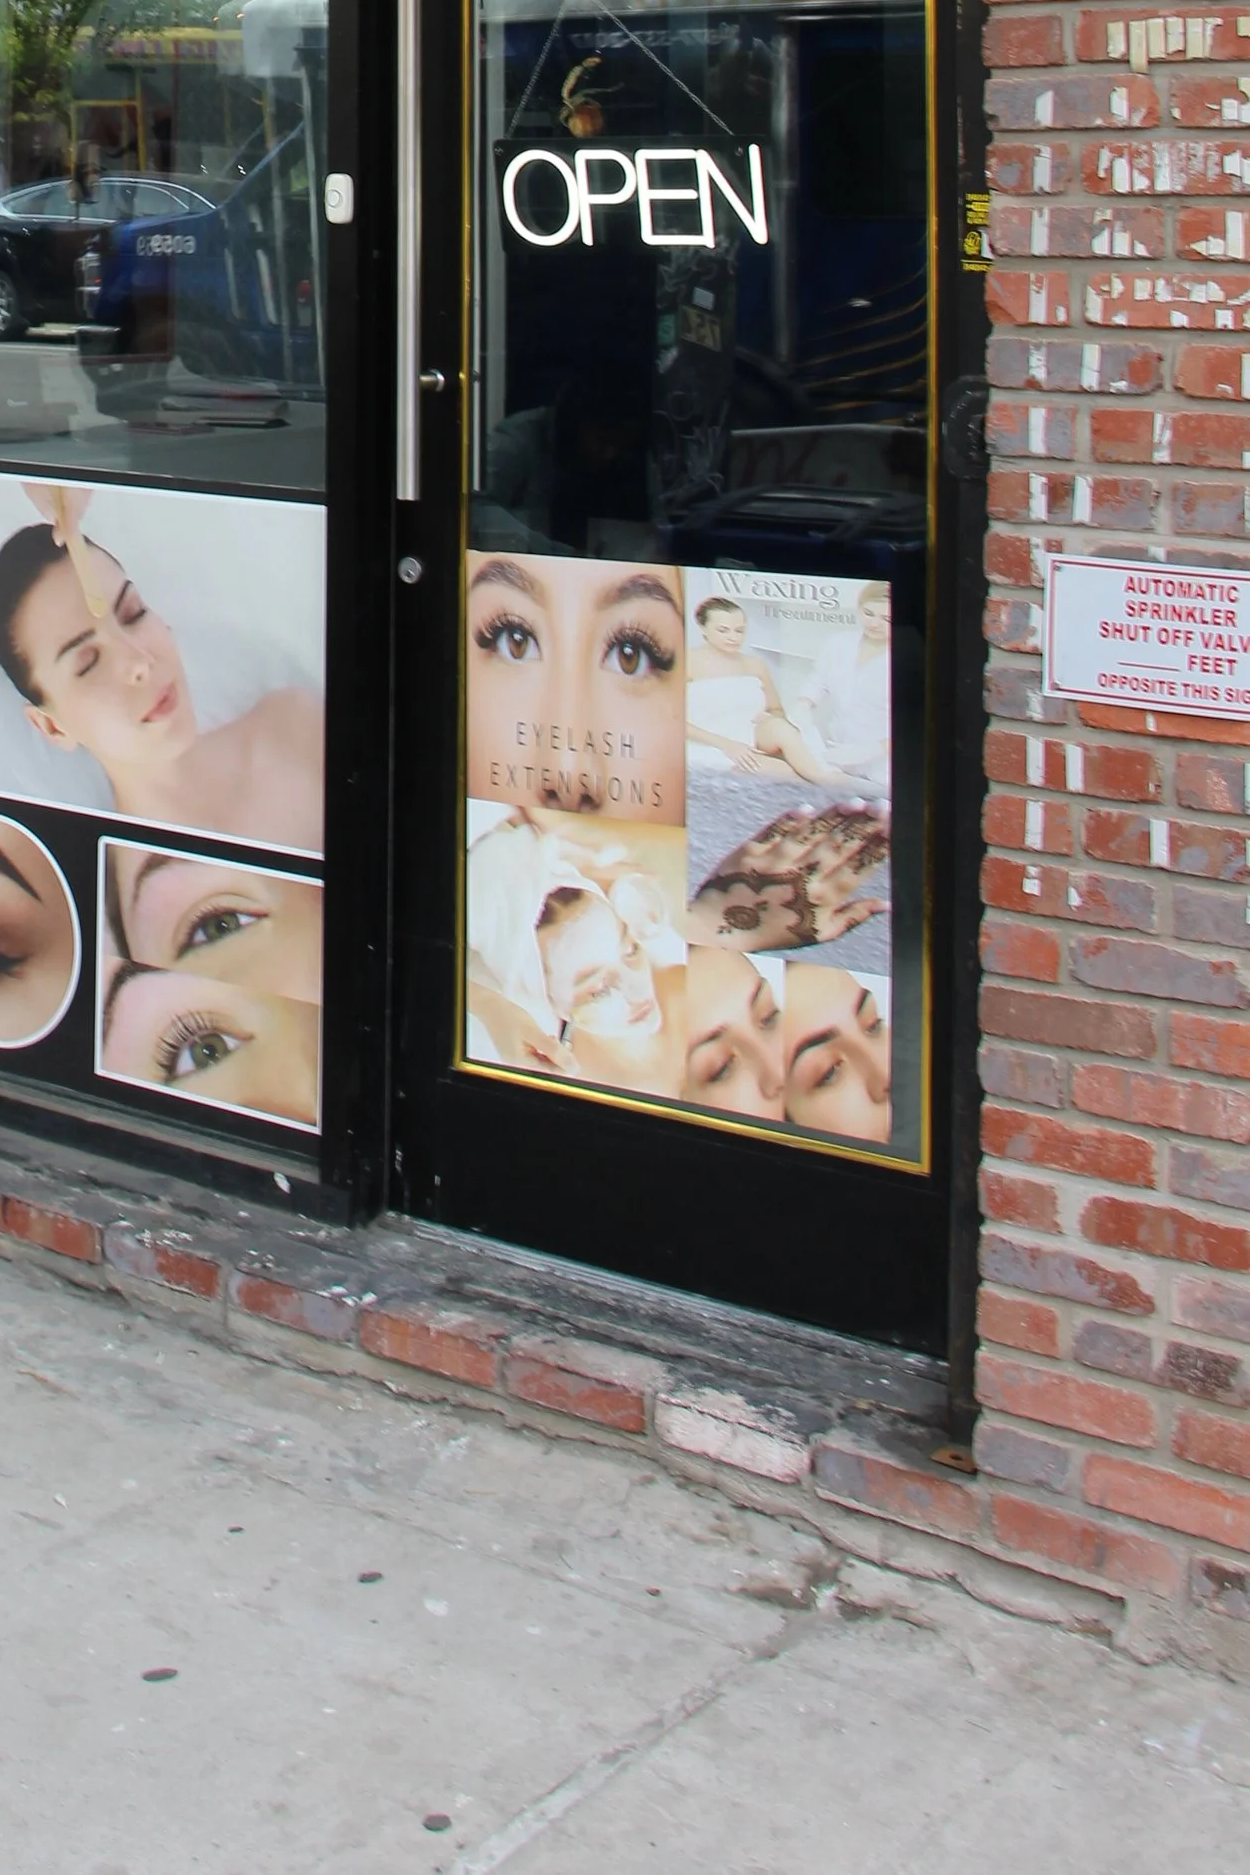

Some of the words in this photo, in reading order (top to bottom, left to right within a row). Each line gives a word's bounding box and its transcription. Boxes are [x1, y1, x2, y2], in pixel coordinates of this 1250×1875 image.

[502, 143, 770, 248] OPEN
[1123, 575, 1240, 604] AUTOMATIC
[763, 603, 858, 626] Treatment
[1124, 599, 1239, 628] SPRINKLER
[1099, 620, 1152, 643] SHUT
[1156, 627, 1195, 648] OFF
[1186, 654, 1238, 676] FEET
[1097, 672, 1179, 697] OPPOSITE
[1180, 682, 1221, 702] THIS
[516, 720, 636, 759] EYELASH
[489, 761, 665, 808] EXTENSIONS
